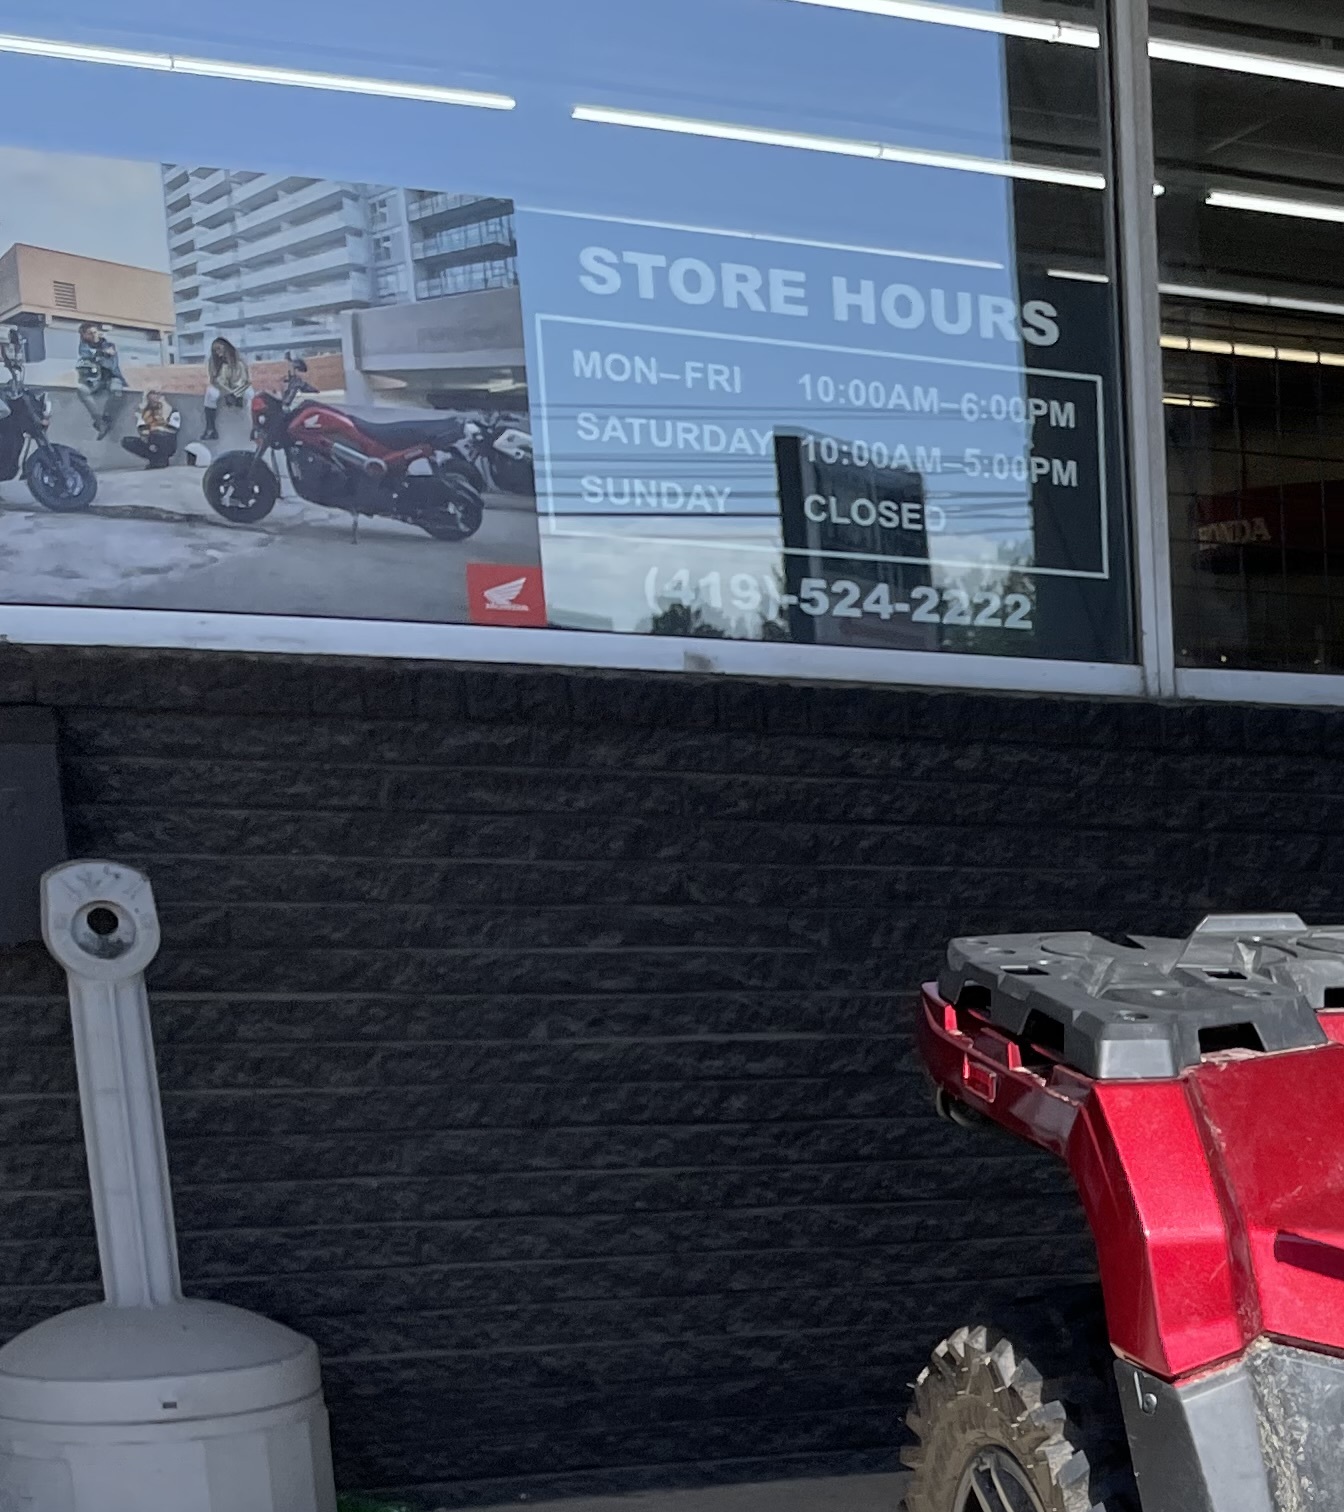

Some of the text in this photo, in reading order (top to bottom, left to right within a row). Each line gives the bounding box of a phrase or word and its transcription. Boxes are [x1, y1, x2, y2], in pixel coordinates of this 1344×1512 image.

[578, 245, 1060, 347] STORE HOURS
[576, 412, 773, 457] SATURDAY
[580, 476, 731, 515] SUNDAY
[803, 494, 946, 533] CLOSED
